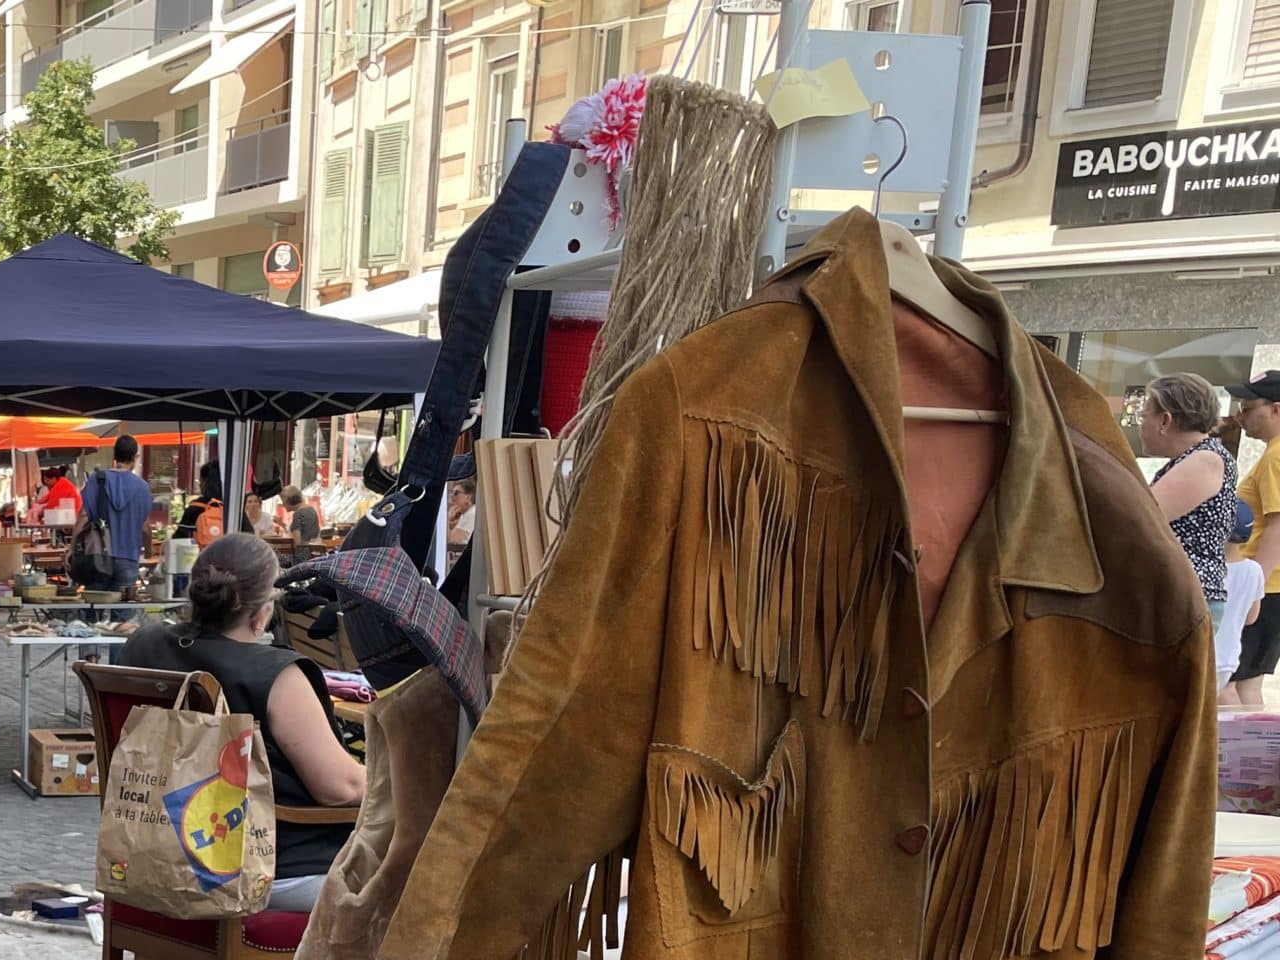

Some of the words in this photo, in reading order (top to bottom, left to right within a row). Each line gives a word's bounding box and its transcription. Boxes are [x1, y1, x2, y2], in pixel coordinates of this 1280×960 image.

[1072, 131, 1280, 178] BABOUCHKA
[1087, 189, 1103, 200] LA
[1107, 184, 1158, 198] CUISINE
[1184, 179, 1221, 191] FAITE
[1225, 173, 1279, 188] MAISON
[122, 768, 158, 786] Invite
[158, 774, 168, 787] la
[119, 787, 150, 804] local
[125, 808, 137, 821] ta
